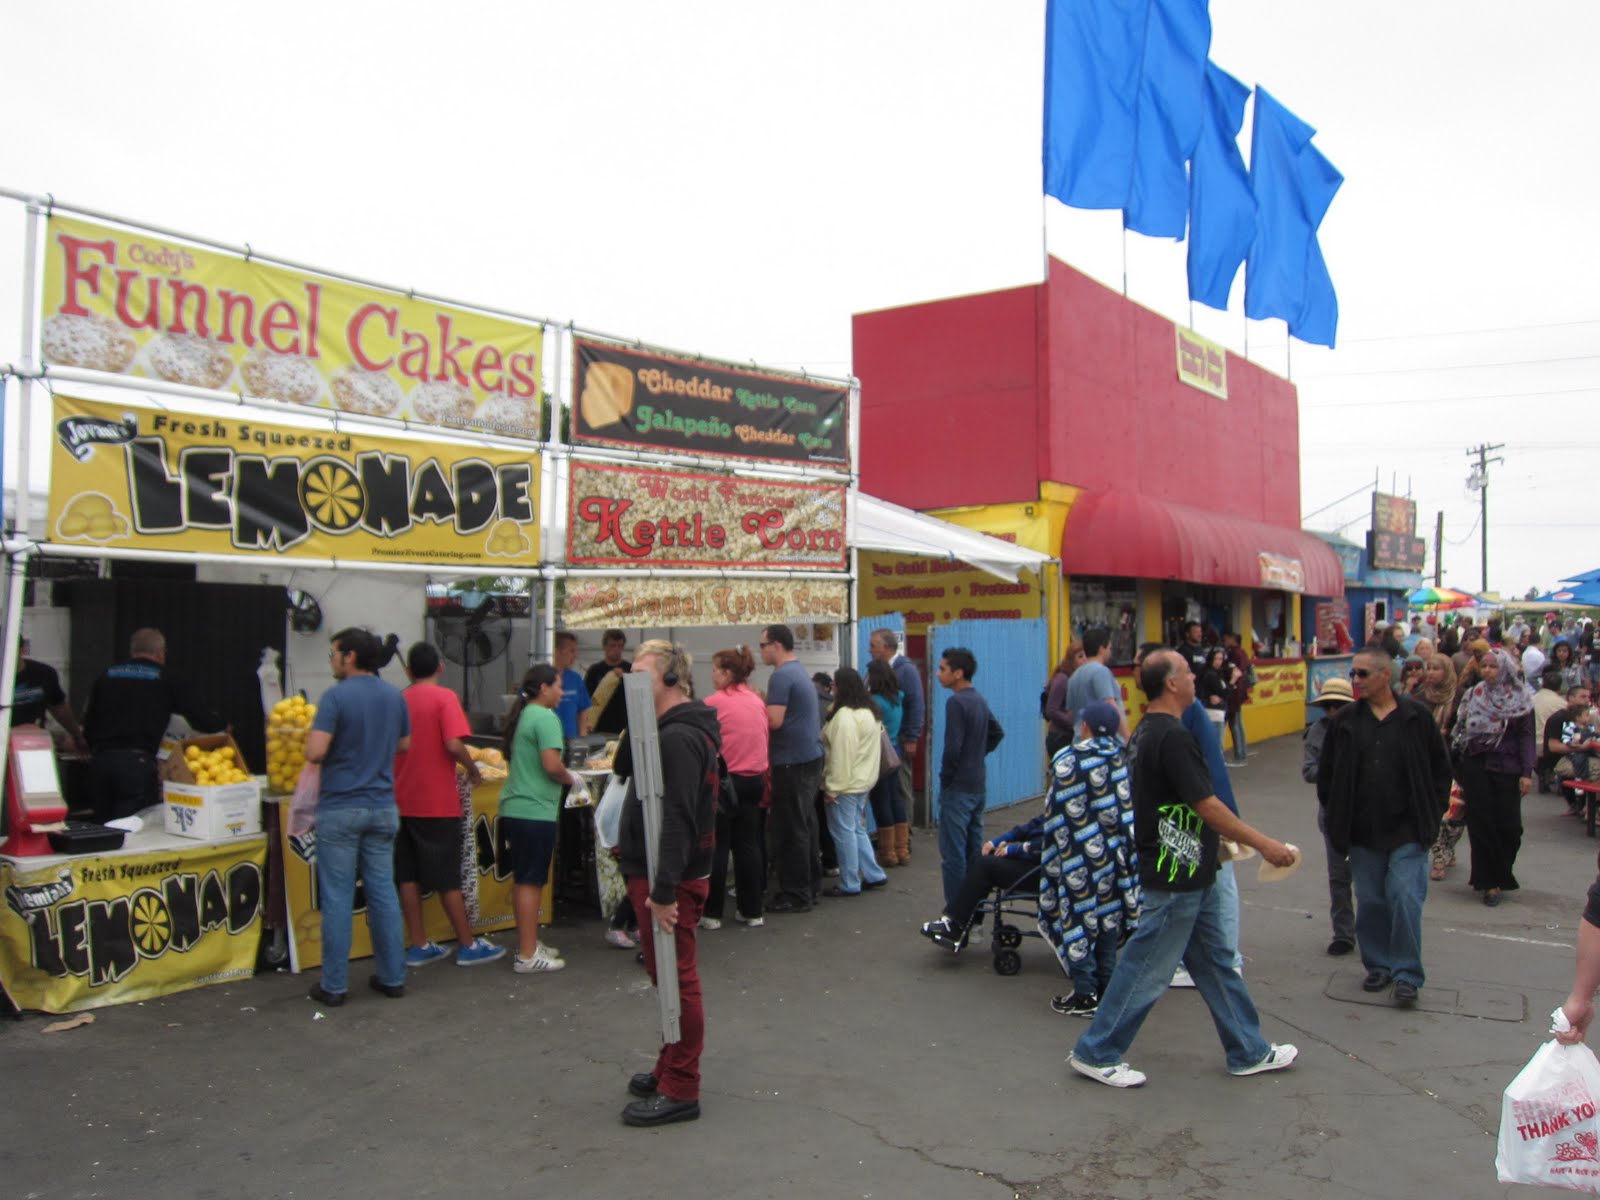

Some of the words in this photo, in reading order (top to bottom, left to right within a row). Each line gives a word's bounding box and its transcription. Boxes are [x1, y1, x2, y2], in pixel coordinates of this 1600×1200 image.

[57, 232, 321, 359] Funnel
[346, 302, 536, 399] Cakes
[638, 368, 733, 401] Cheddar
[153, 415, 226, 438] Fresh
[238, 424, 351, 451] Squeezed
[635, 405, 732, 438] Jalapeño
[735, 425, 796, 445] Cheddar
[798, 432, 832, 451] Corn
[127, 437, 534, 552] LEMONADE
[636, 476, 709, 502] World
[717, 482, 795, 509] Famous
[577, 496, 726, 557] Kettle
[741, 509, 842, 552] Corn
[594, 587, 703, 618] Caramel
[712, 586, 785, 623] Kettle
[792, 587, 842, 615] Corn
[81, 864, 115, 883] Fresh
[120, 857, 182, 882] Squeezed
[29, 862, 265, 988] LEMONAD
[1517, 1112, 1571, 1141] THANK
[1571, 1101, 1595, 1121] YO
